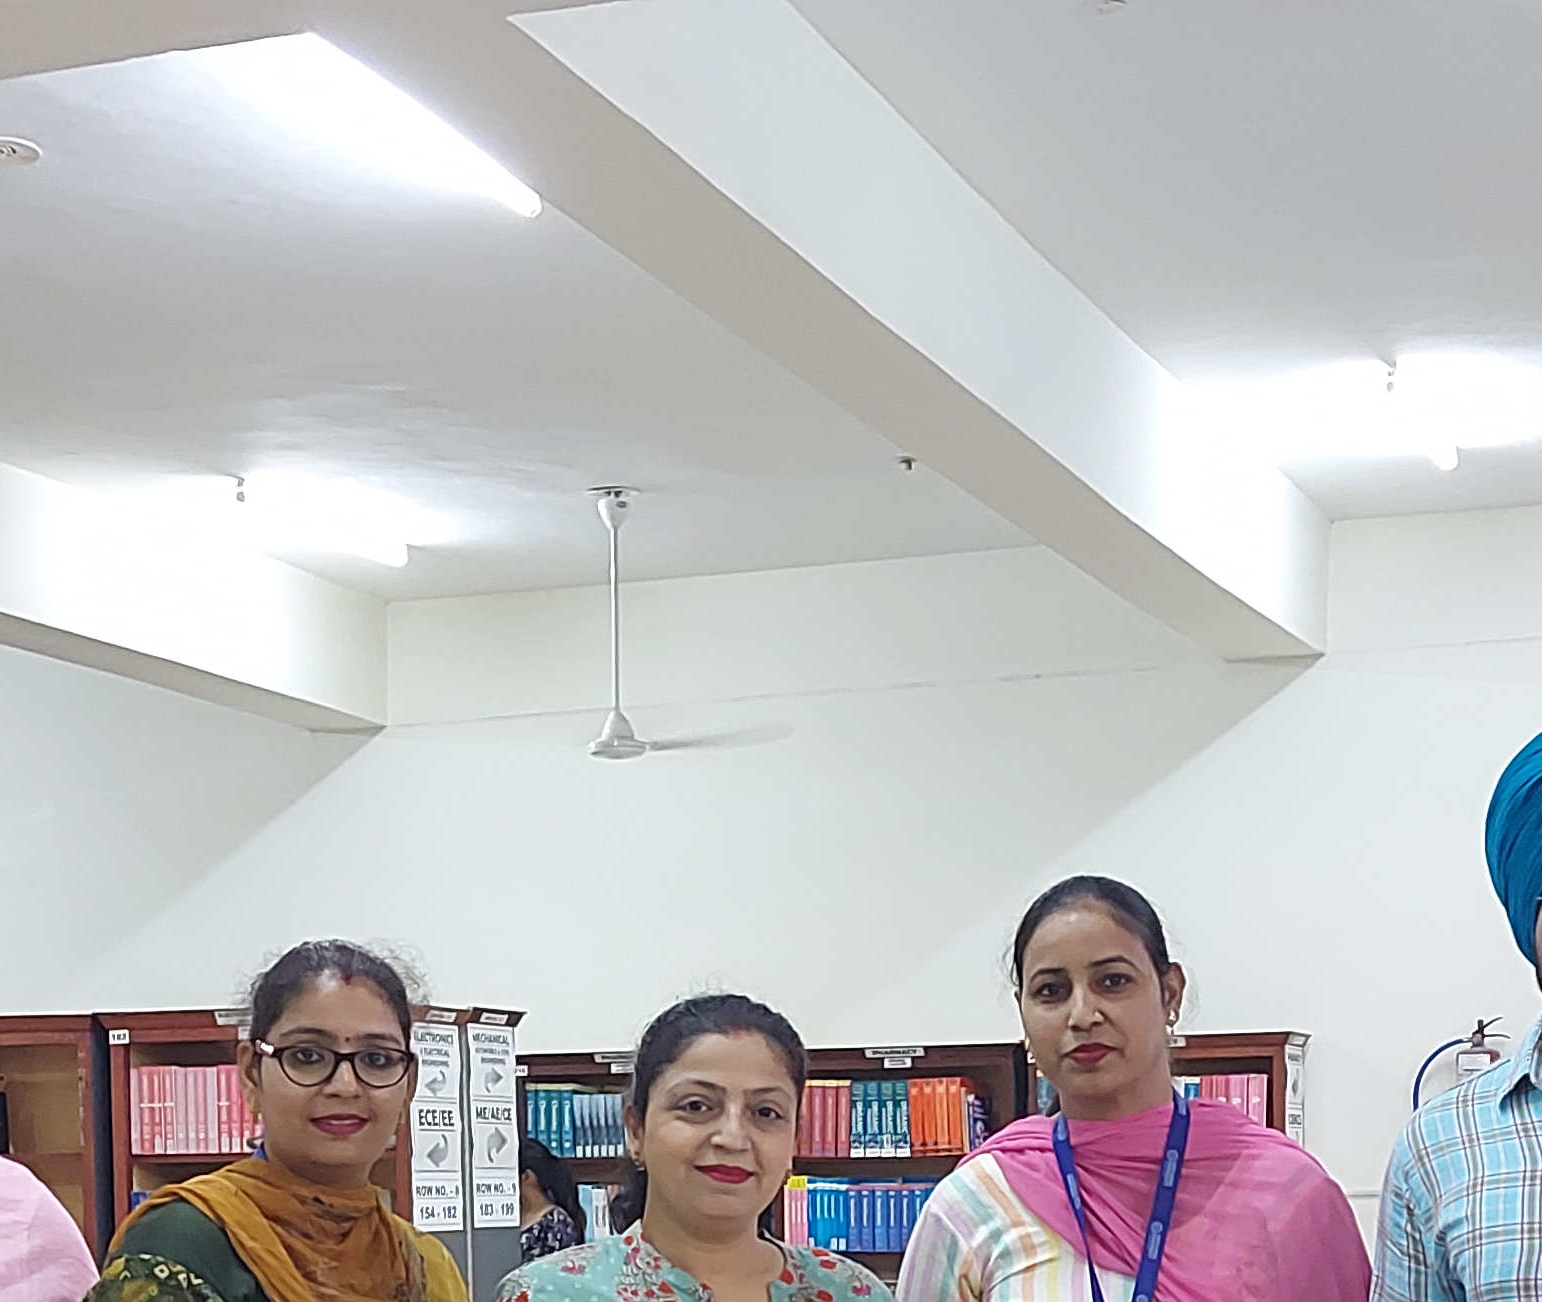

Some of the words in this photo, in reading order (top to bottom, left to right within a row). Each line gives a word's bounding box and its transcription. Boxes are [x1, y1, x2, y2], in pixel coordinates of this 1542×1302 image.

[418, 1109, 455, 1127] ECE/EE
[416, 1185, 433, 1196] ROW
[435, 1185, 448, 1196] NO.
[477, 1184, 492, 1194] ROW
[494, 1183, 505, 1194] NO.
[420, 1206, 435, 1219] 154
